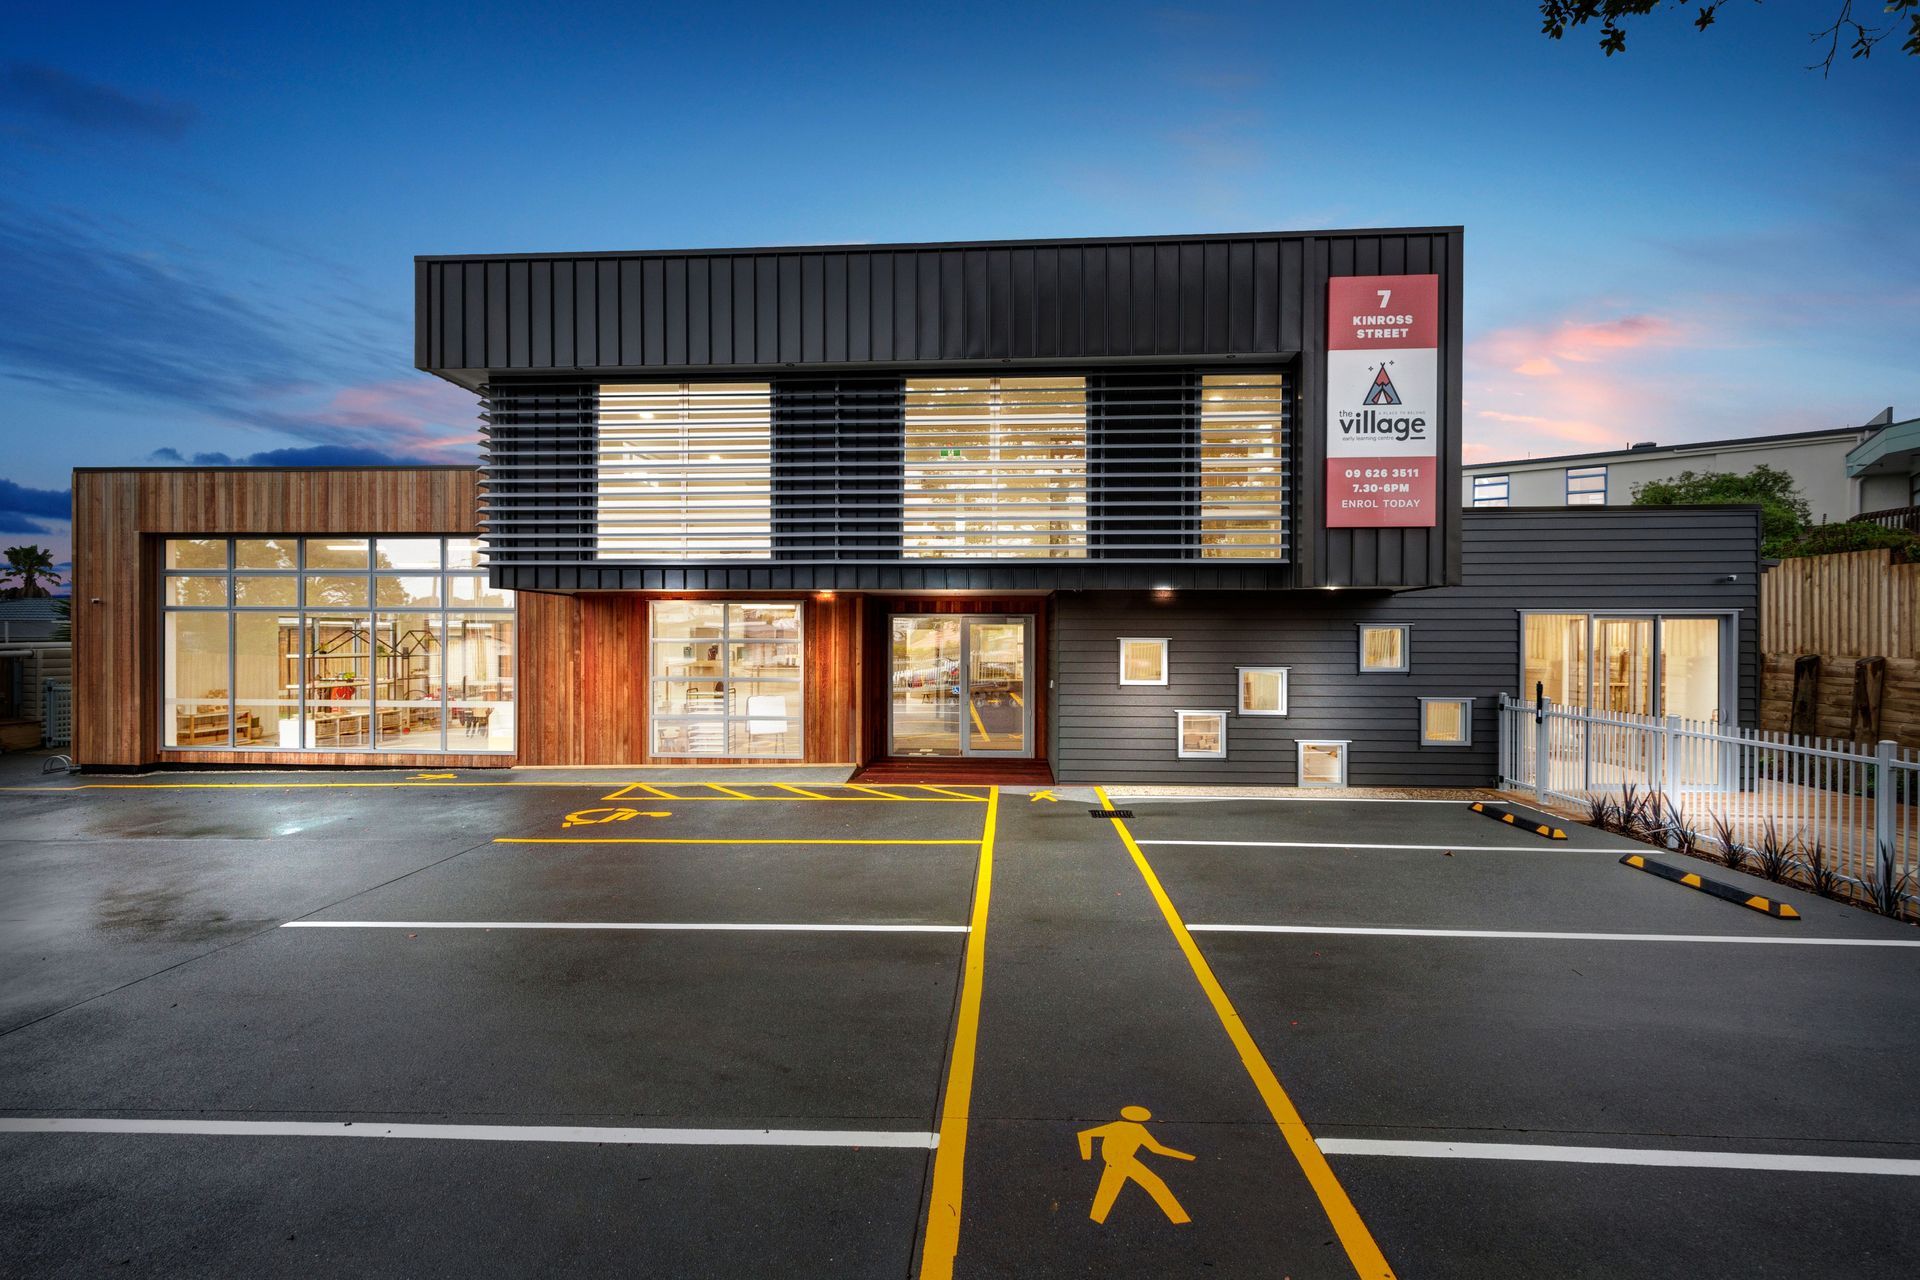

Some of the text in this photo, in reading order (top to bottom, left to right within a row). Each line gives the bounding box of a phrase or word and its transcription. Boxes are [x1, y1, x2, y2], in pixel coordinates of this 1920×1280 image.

[1377, 289, 1392, 308] 7
[1352, 315, 1413, 325] KINROSS
[1356, 328, 1409, 338] STREET
[1339, 410, 1353, 418] the
[1339, 410, 1426, 441] village
[1345, 468, 1419, 478] 09 626 3511
[1352, 483, 1410, 493] 7.30-6PM
[1341, 499, 1421, 508] ENROL TODAY
